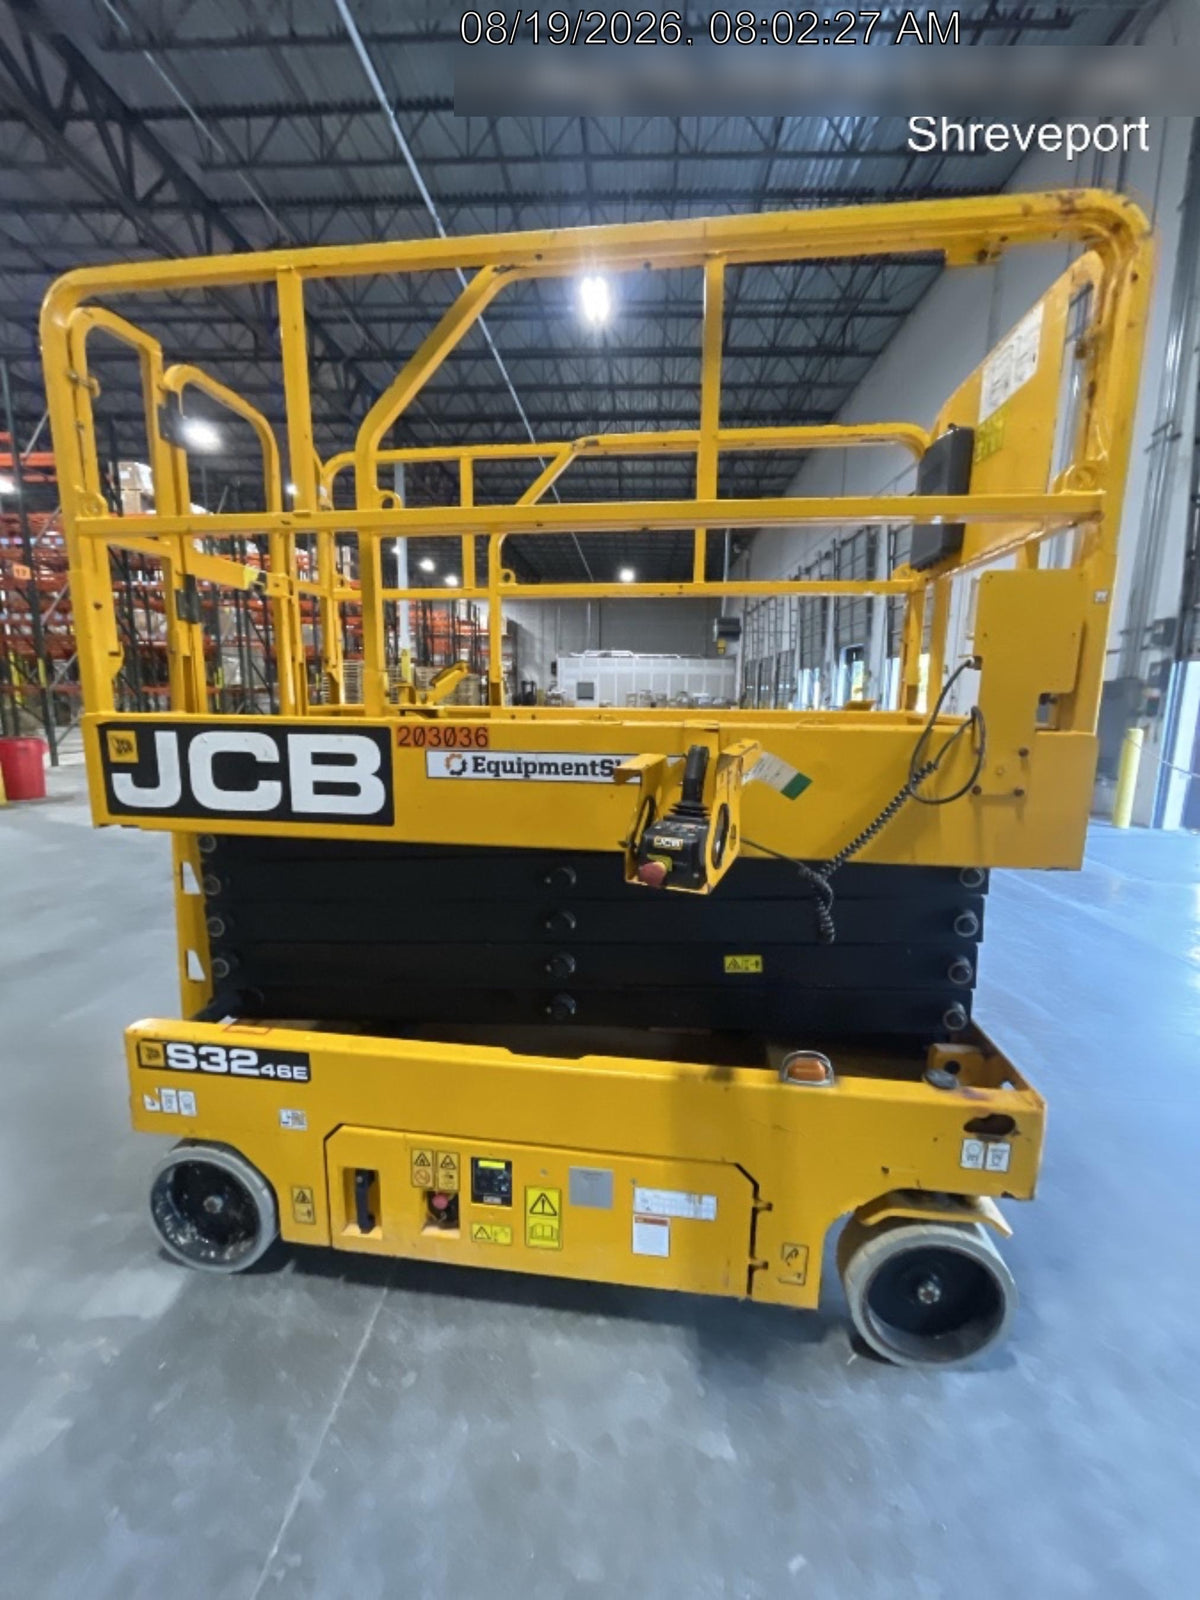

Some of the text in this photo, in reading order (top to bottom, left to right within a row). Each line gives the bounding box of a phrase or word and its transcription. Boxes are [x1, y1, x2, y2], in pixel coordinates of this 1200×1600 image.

[397, 726, 489, 748] 203036
[111, 730, 386, 815] JCB
[472, 755, 622, 779] EquipmentS
